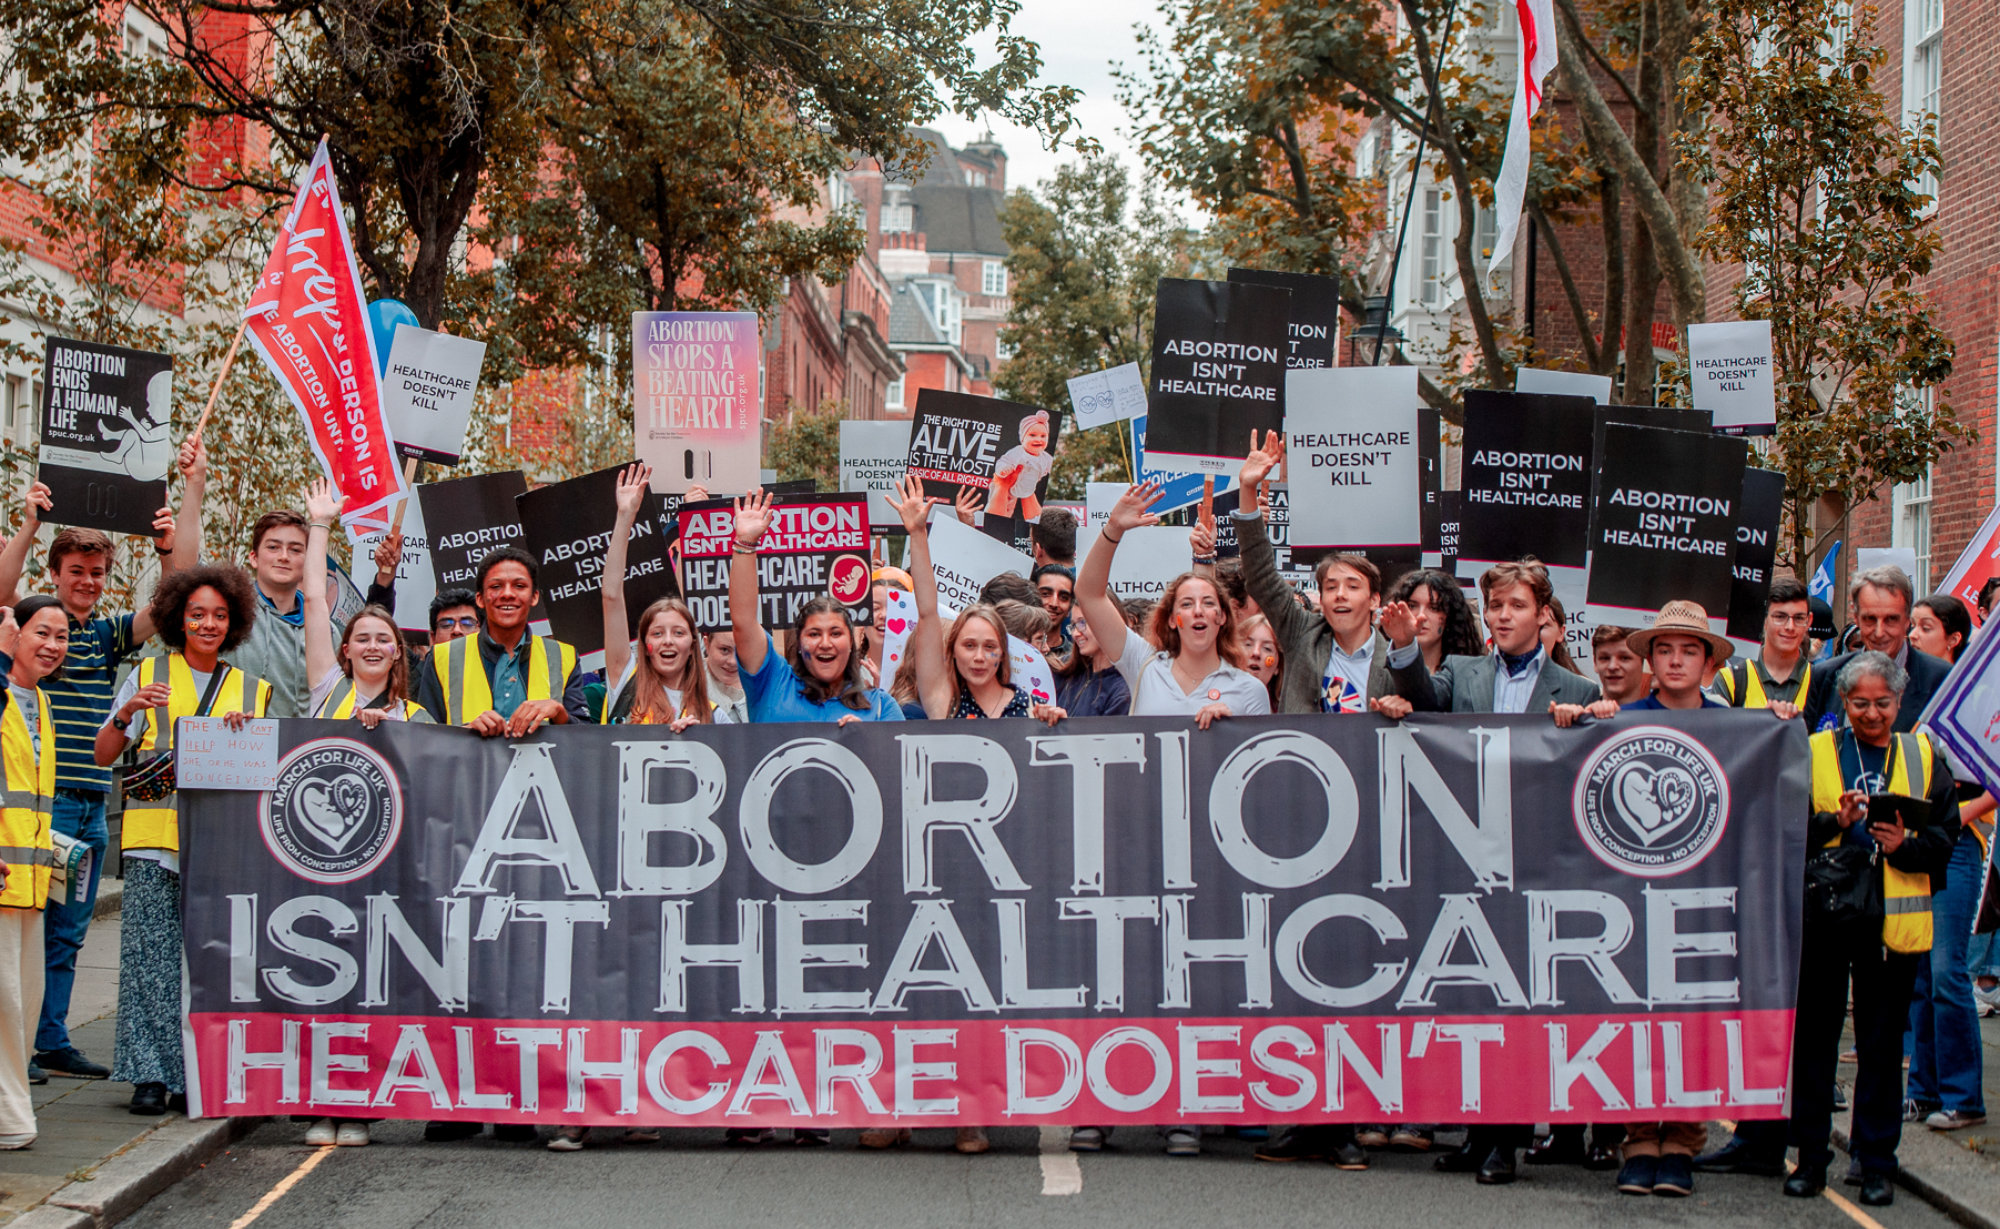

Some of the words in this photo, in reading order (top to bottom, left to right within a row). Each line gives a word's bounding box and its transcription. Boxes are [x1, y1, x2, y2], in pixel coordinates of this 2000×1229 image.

[648, 321, 734, 342] ABORTION
[53, 347, 126, 377] ABORTION
[648, 343, 715, 369] STOPS
[721, 345, 734, 369] A
[1163, 339, 1278, 364] ABORTION
[1696, 357, 1767, 368] HEALTHCARE
[272, 324, 330, 410] ABORTION
[393, 364, 471, 390] HEALTHCARE
[1192, 361, 1246, 381] ISN'T
[1708, 369, 1757, 380] DOESN'T
[52, 367, 90, 391] ENDS
[648, 370, 734, 396] BEATING
[1159, 379, 1277, 401] HEALTHCARE
[1720, 382, 1745, 392] KILL
[403, 380, 456, 401] DOESN'T
[51, 388, 61, 407] A
[65, 390, 118, 416] HUMAN
[412, 395, 438, 411] KILL
[648, 396, 737, 429] HEART
[49, 408, 77, 430] LIFE
[923, 414, 941, 425] THE
[941, 417, 970, 429] RIGHT
[972, 420, 986, 431] TO
[987, 423, 1002, 435] BE
[48, 430, 95, 442] spuc.org.uk
[911, 424, 1001, 463] ALIVE
[1293, 432, 1410, 448] HEALTHCARE
[908, 452, 919, 466] IS
[922, 453, 947, 470] THE
[950, 457, 994, 477] MOST
[1312, 452, 1391, 467] DOESN'T
[1472, 450, 1583, 471] ABORTION
[358, 465, 377, 491] IS
[855, 470, 905, 479] DOESN'T
[868, 481, 893, 490] KILL
[908, 467, 929, 479] BASIC
[930, 471, 941, 480] OF
[941, 472, 955, 482] ALL
[956, 474, 989, 489] RIGHTS
[1331, 472, 1371, 486] KILL
[1500, 471, 1552, 490] ISN'T
[1468, 489, 1582, 508] HEALTHCARE
[1609, 488, 1730, 517] ABORTION
[685, 506, 860, 538] ABRTION
[1638, 512, 1696, 534] ISN'T
[543, 520, 652, 565] ABORTON
[684, 537, 732, 555] ISN'T
[1603, 529, 1727, 556] HEALTHCARE
[550, 558, 664, 601] HEALTARE
[686, 555, 827, 590] HEAHCARE
[183, 720, 209, 733] THE
[185, 740, 216, 751] HELP
[228, 740, 264, 751] HOW
[183, 757, 200, 766] SHE
[223, 760, 235, 768] HE
[244, 760, 266, 768] WAS
[1592, 740, 1642, 784] MARCH
[1644, 739, 1676, 756] FOR
[1676, 747, 1705, 775] LIFE
[1700, 773, 1718, 798] UK
[184, 771, 276, 787] CONCEIVED!
[273, 757, 312, 808] MARCH
[312, 751, 343, 770] FOR
[344, 752, 377, 779] LIFE
[371, 775, 388, 793] UK
[1587, 789, 1596, 811] LIFE
[453, 725, 1515, 899] ABORTION
[272, 813, 285, 836] LIFE
[280, 832, 302, 859] FROM
[300, 854, 359, 871] CONCEPTION
[363, 845, 377, 859] NO
[373, 796, 391, 852] EXCEPTION
[1588, 810, 1604, 839] FROM
[1687, 803, 1718, 851] EXCEPTION
[1603, 836, 1665, 864] CONCEPTION
[1672, 848, 1688, 860] NO
[225, 890, 611, 1016] ISN'T
[655, 883, 1741, 1019] HEALTHCARE
[225, 1016, 961, 1118] HEALTHCARE
[1000, 1018, 1505, 1117] DOESN'T
[1544, 1018, 1788, 1113] KILL
